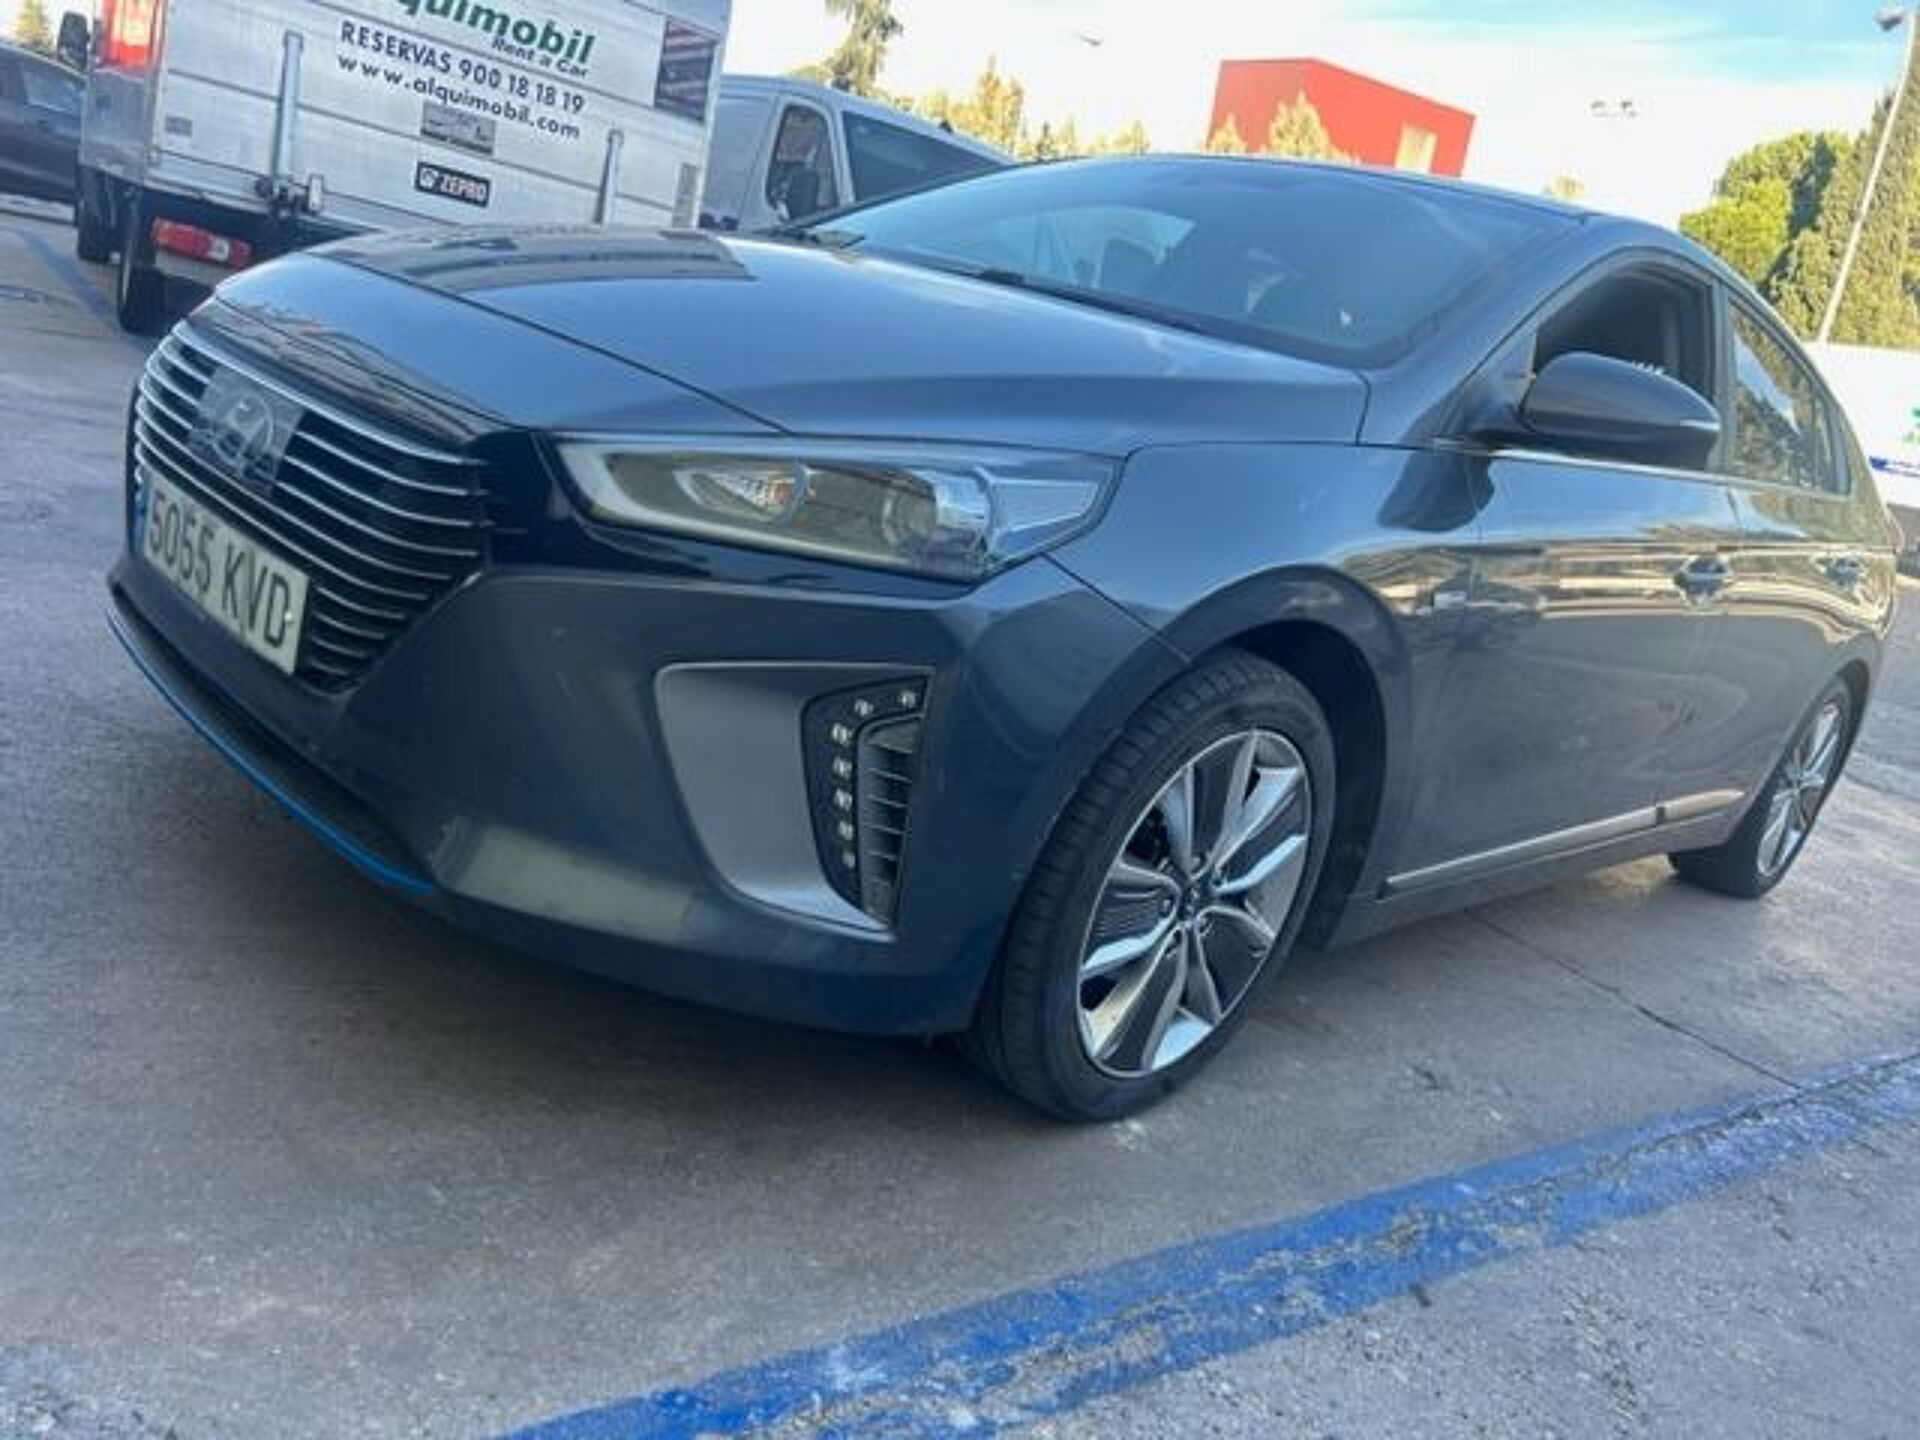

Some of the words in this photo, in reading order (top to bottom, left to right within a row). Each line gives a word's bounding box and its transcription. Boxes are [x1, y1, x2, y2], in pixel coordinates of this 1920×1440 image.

[341, 21, 451, 74] RESERVAS
[459, 59, 501, 89] 900
[509, 74, 529, 98] 18
[536, 83, 556, 106] 18
[563, 91, 585, 115] 19
[492, 37, 535, 61] Rent
[539, 54, 552, 68] a
[556, 59, 589, 77] Car
[221, 542, 291, 648] KVD
